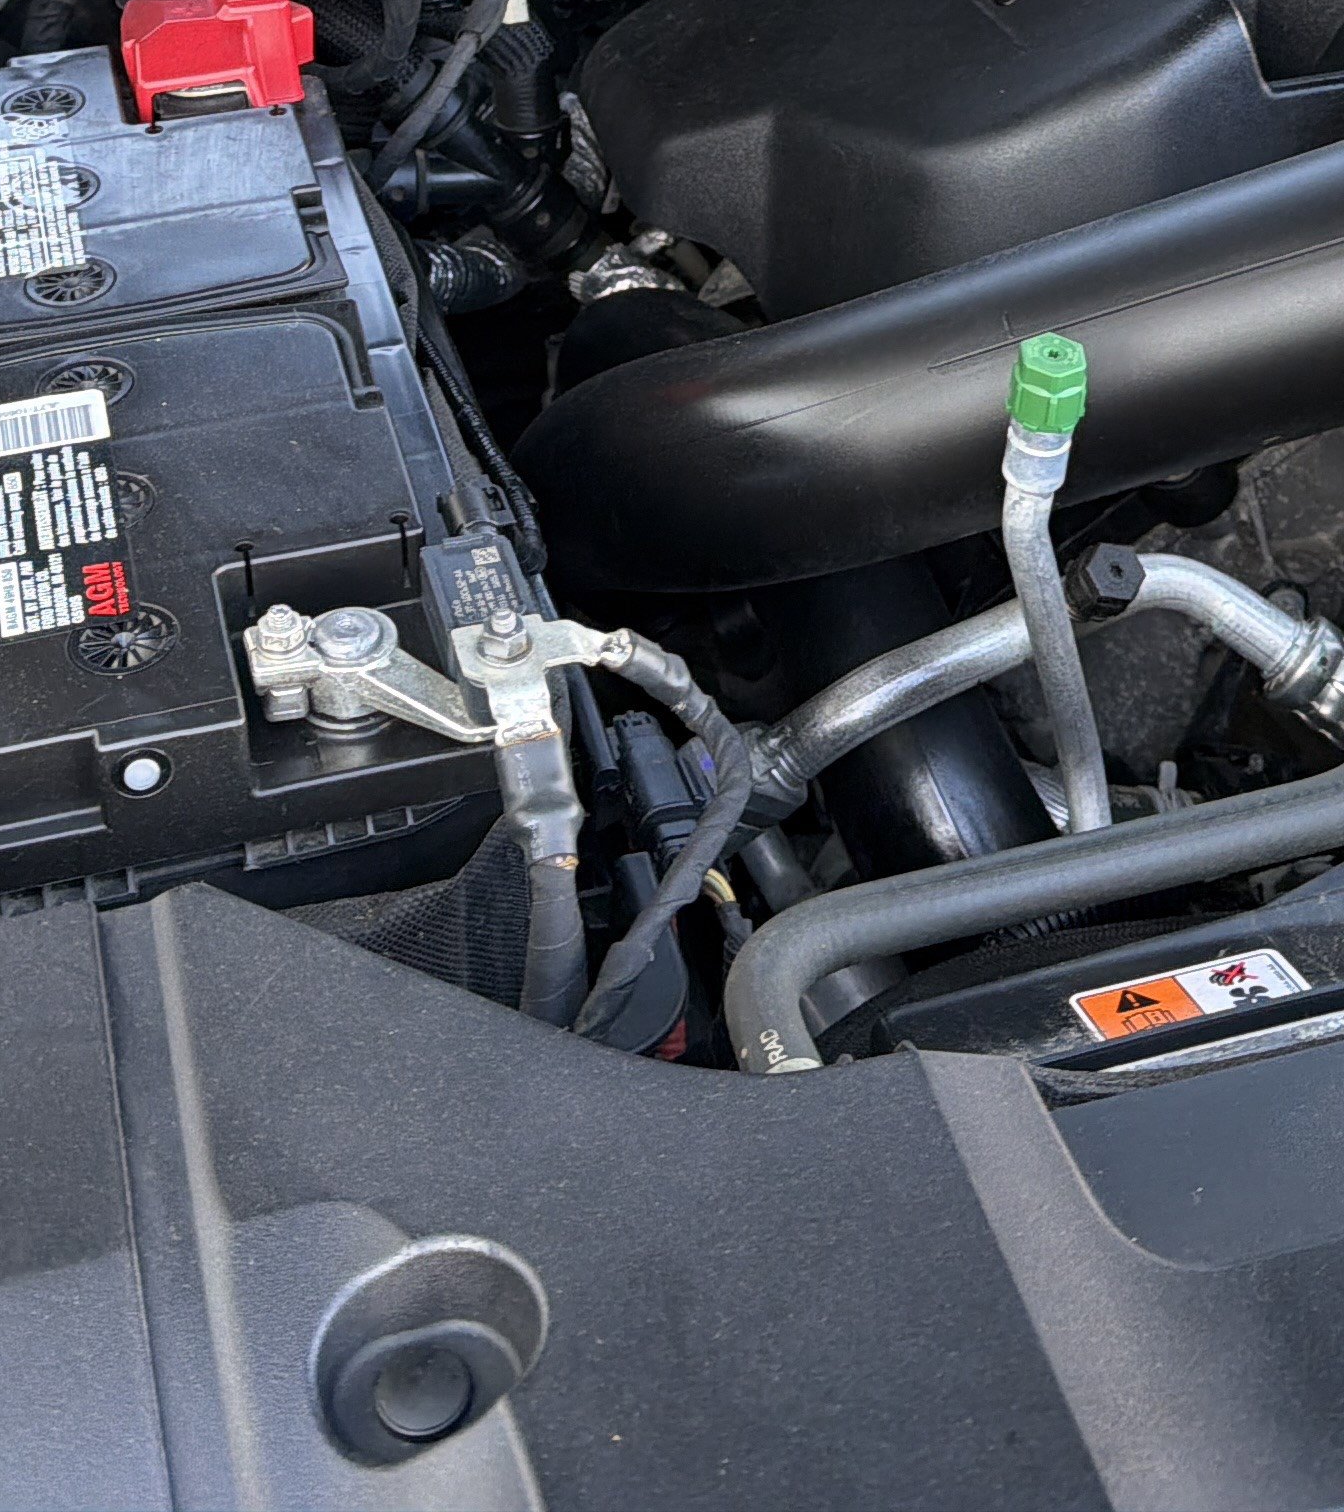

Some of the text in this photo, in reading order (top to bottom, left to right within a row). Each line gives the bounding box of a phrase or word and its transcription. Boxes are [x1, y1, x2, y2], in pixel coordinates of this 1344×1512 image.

[37, 582, 54, 608] MOTOR
[82, 562, 117, 615] AGM
[112, 562, 130, 614] TECHNOLOGY
[758, 1028, 789, 1065] RAD
